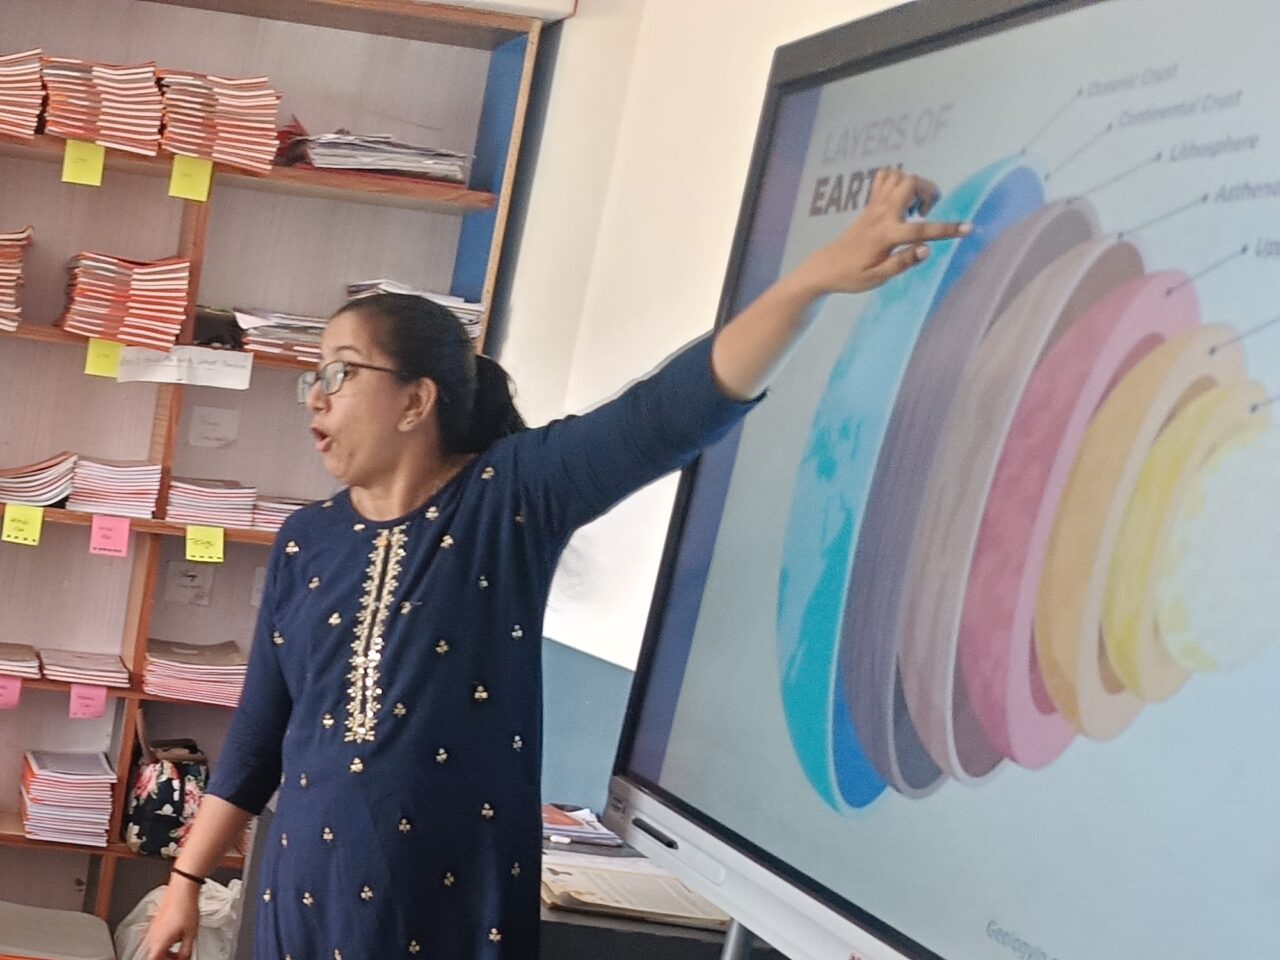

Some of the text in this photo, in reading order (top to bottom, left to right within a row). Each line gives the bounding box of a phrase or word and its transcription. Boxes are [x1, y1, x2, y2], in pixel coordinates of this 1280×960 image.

[822, 102, 954, 164] LAYERS OF
[1169, 134, 1260, 162] Lithosphere
